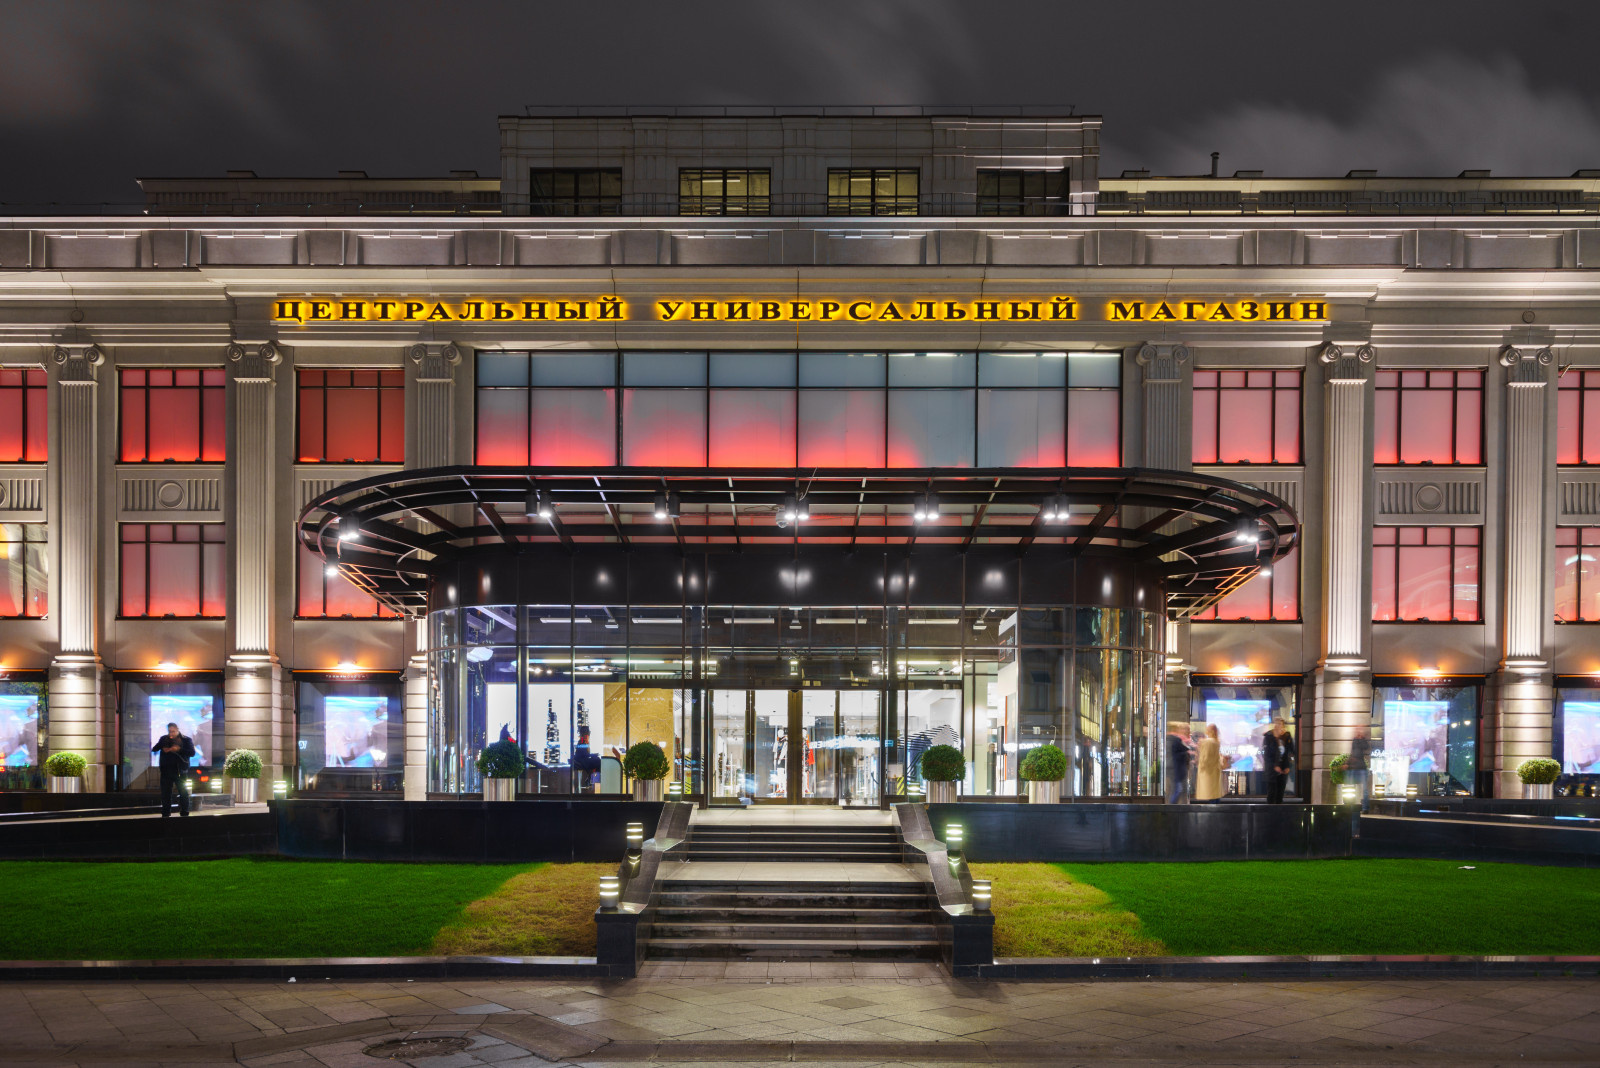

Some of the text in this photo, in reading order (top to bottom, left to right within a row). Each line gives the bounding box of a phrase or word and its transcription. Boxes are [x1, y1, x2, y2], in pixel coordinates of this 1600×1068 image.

[274, 296, 1328, 324] ЦЕНТРАЛЬНЫЙ УНИВЕРСАЛЬНЫЙ МАГАЗИН
